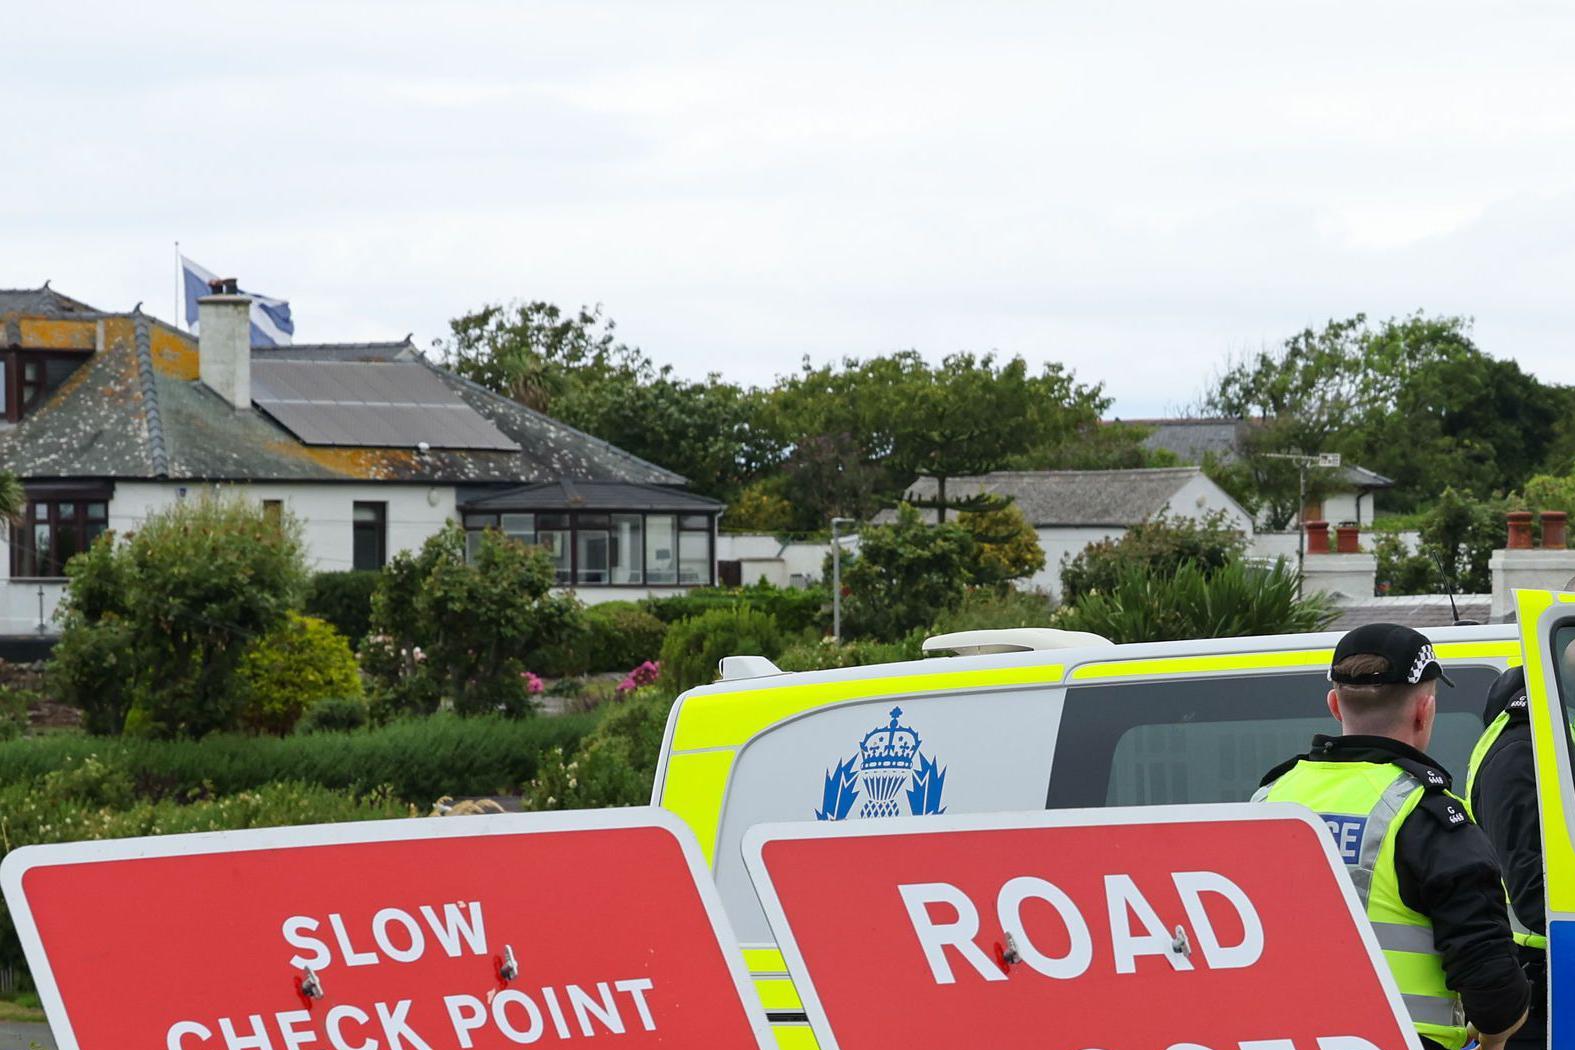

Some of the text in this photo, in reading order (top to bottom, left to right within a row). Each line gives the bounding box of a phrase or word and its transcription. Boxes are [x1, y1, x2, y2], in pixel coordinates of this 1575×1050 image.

[282, 902, 488, 972] SLOW
[897, 871, 1265, 985] ROAD
[443, 978, 657, 1049] POINT
